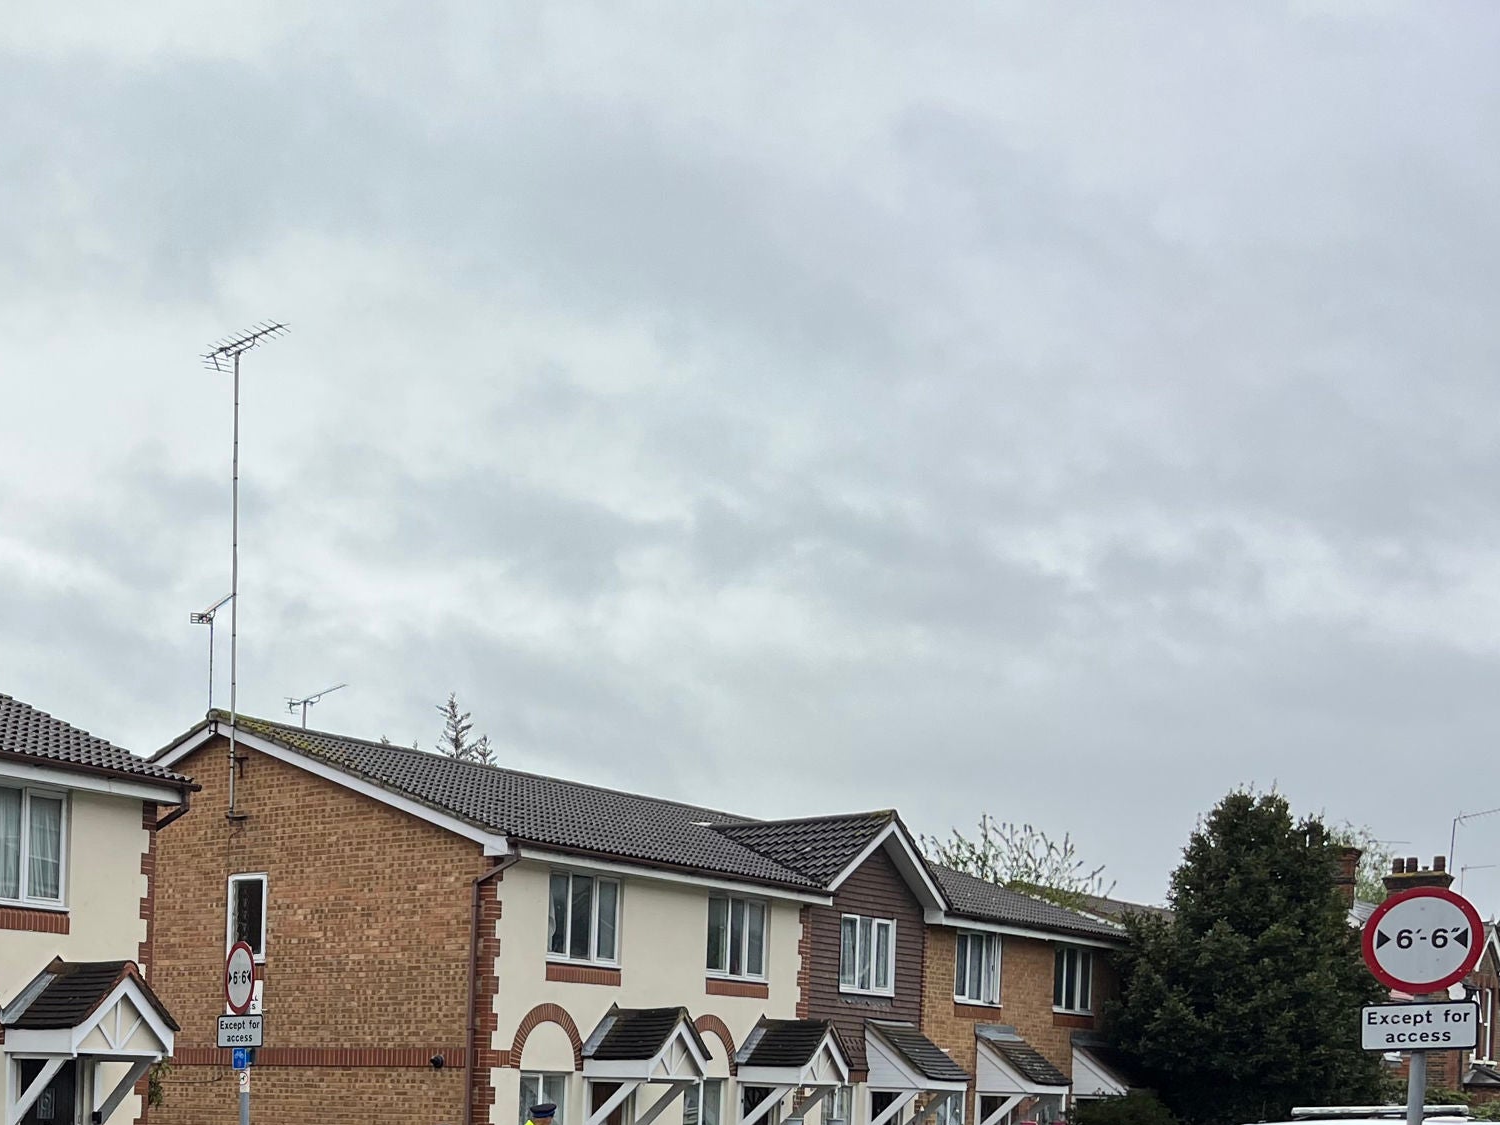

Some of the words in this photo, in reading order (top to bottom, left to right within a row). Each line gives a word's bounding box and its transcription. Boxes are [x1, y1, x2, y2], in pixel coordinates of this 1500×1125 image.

[1367, 1010, 1433, 1027] Except
[1443, 1009, 1470, 1023] for
[219, 1020, 246, 1032] Except
[249, 1019, 260, 1029] for
[226, 1033, 253, 1043] access
[1385, 1031, 1452, 1043] access
